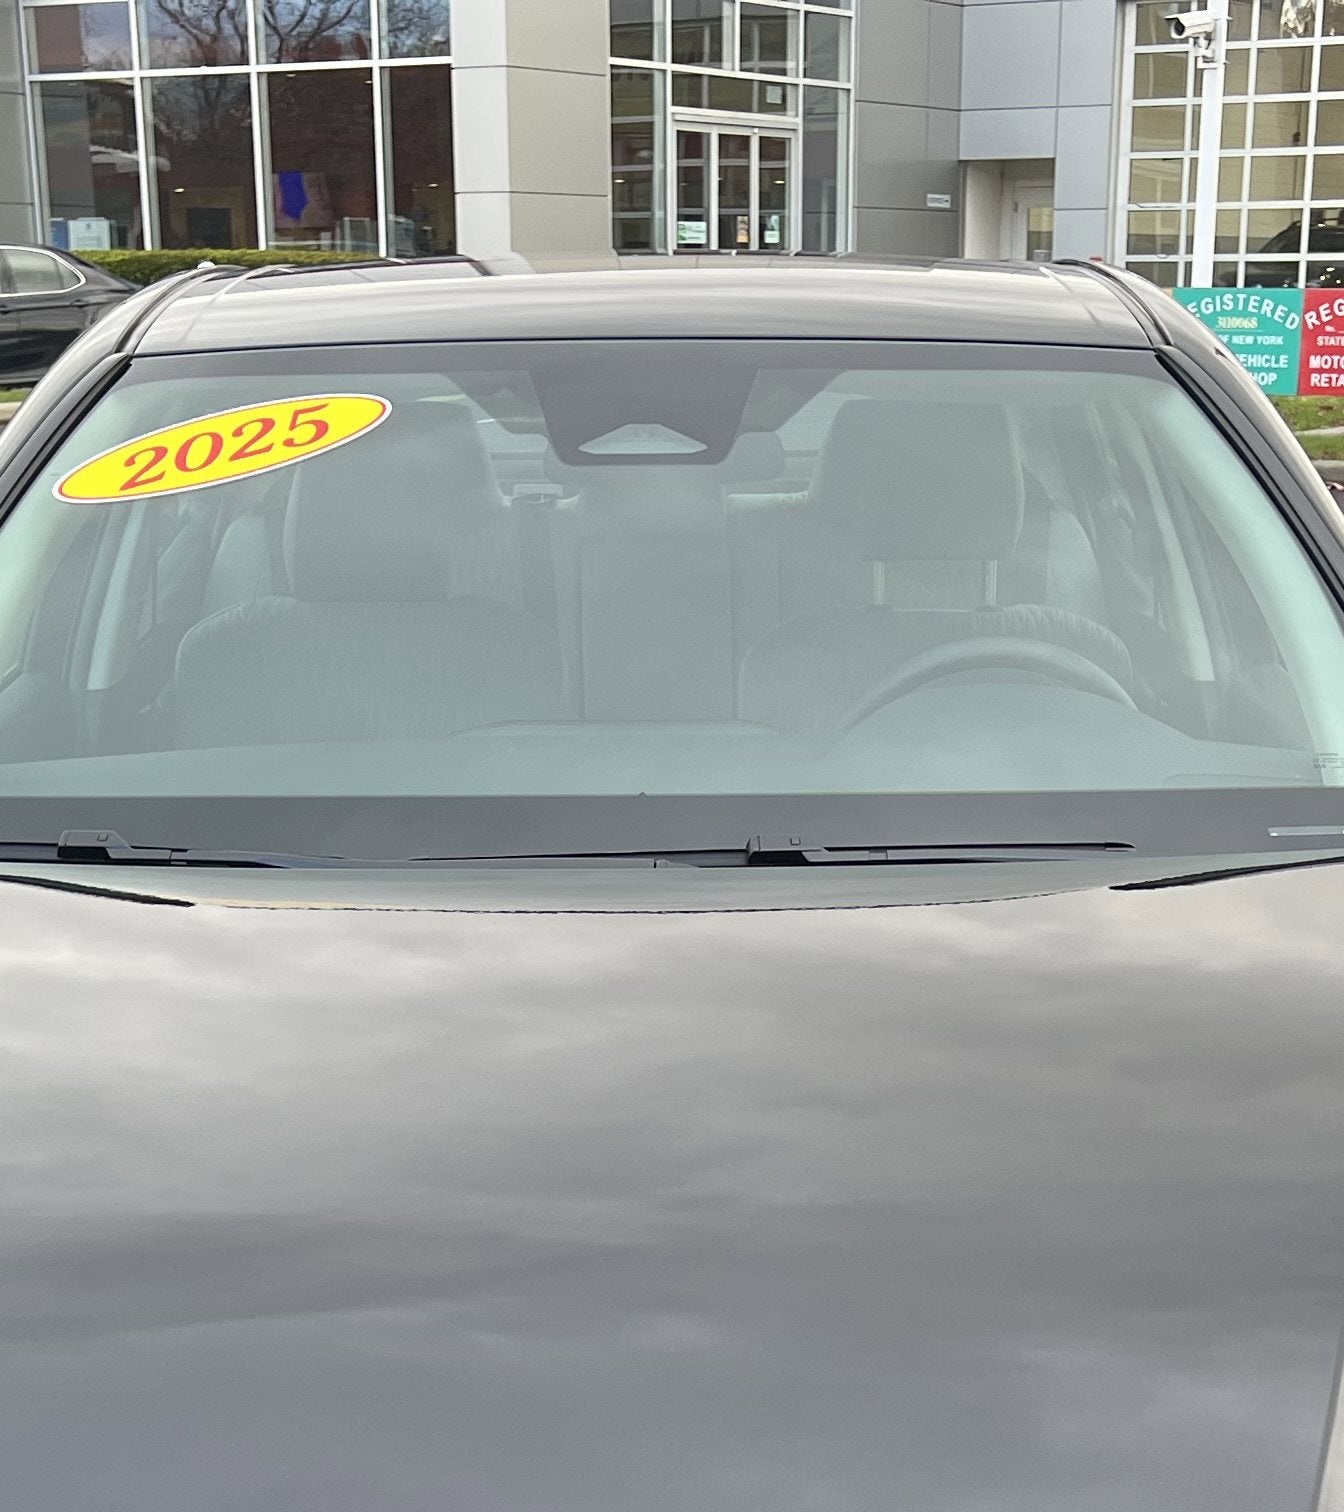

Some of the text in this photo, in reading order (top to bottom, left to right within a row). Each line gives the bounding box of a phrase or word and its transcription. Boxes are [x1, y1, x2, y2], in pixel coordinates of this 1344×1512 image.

[1186, 293, 1300, 330] EGISTERED
[1231, 335, 1255, 345] NEW
[1256, 335, 1284, 346] YORK
[1235, 353, 1289, 369] EHICLE
[119, 403, 330, 491] 2025
